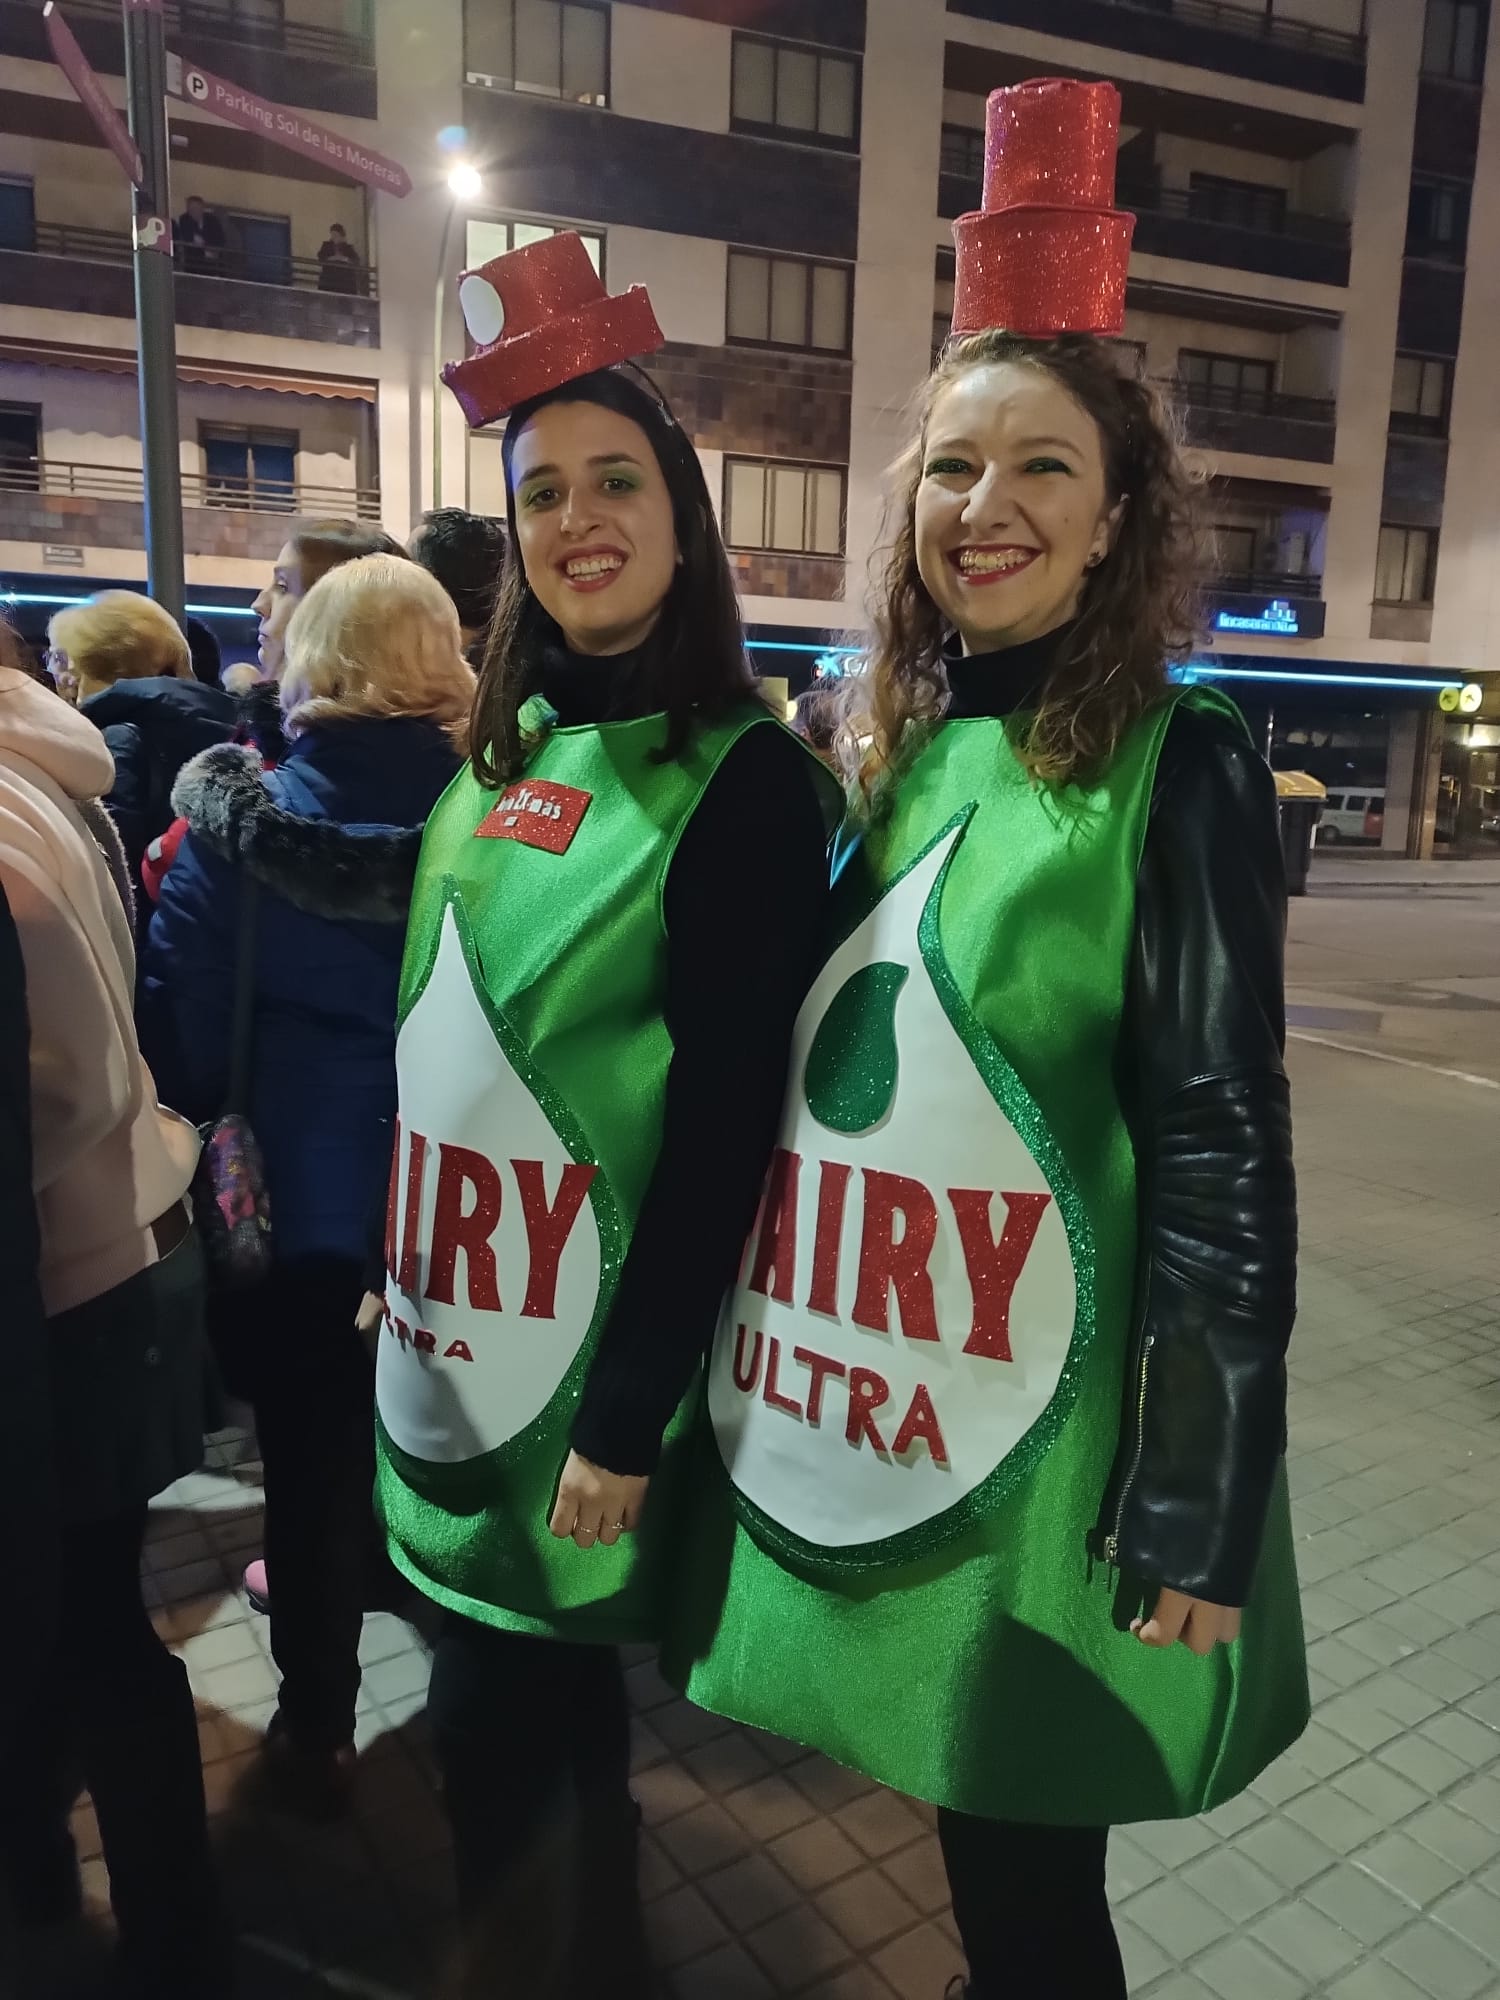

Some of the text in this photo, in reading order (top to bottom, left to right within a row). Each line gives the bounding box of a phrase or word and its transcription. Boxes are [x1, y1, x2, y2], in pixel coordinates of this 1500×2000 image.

[192, 75, 402, 186] P Parking Sol de las Moreras
[384, 1117, 600, 1320] IRY
[746, 1146, 1052, 1363] AIRY
[384, 1296, 475, 1363] TRA
[732, 1322, 949, 1464] ULTRA
